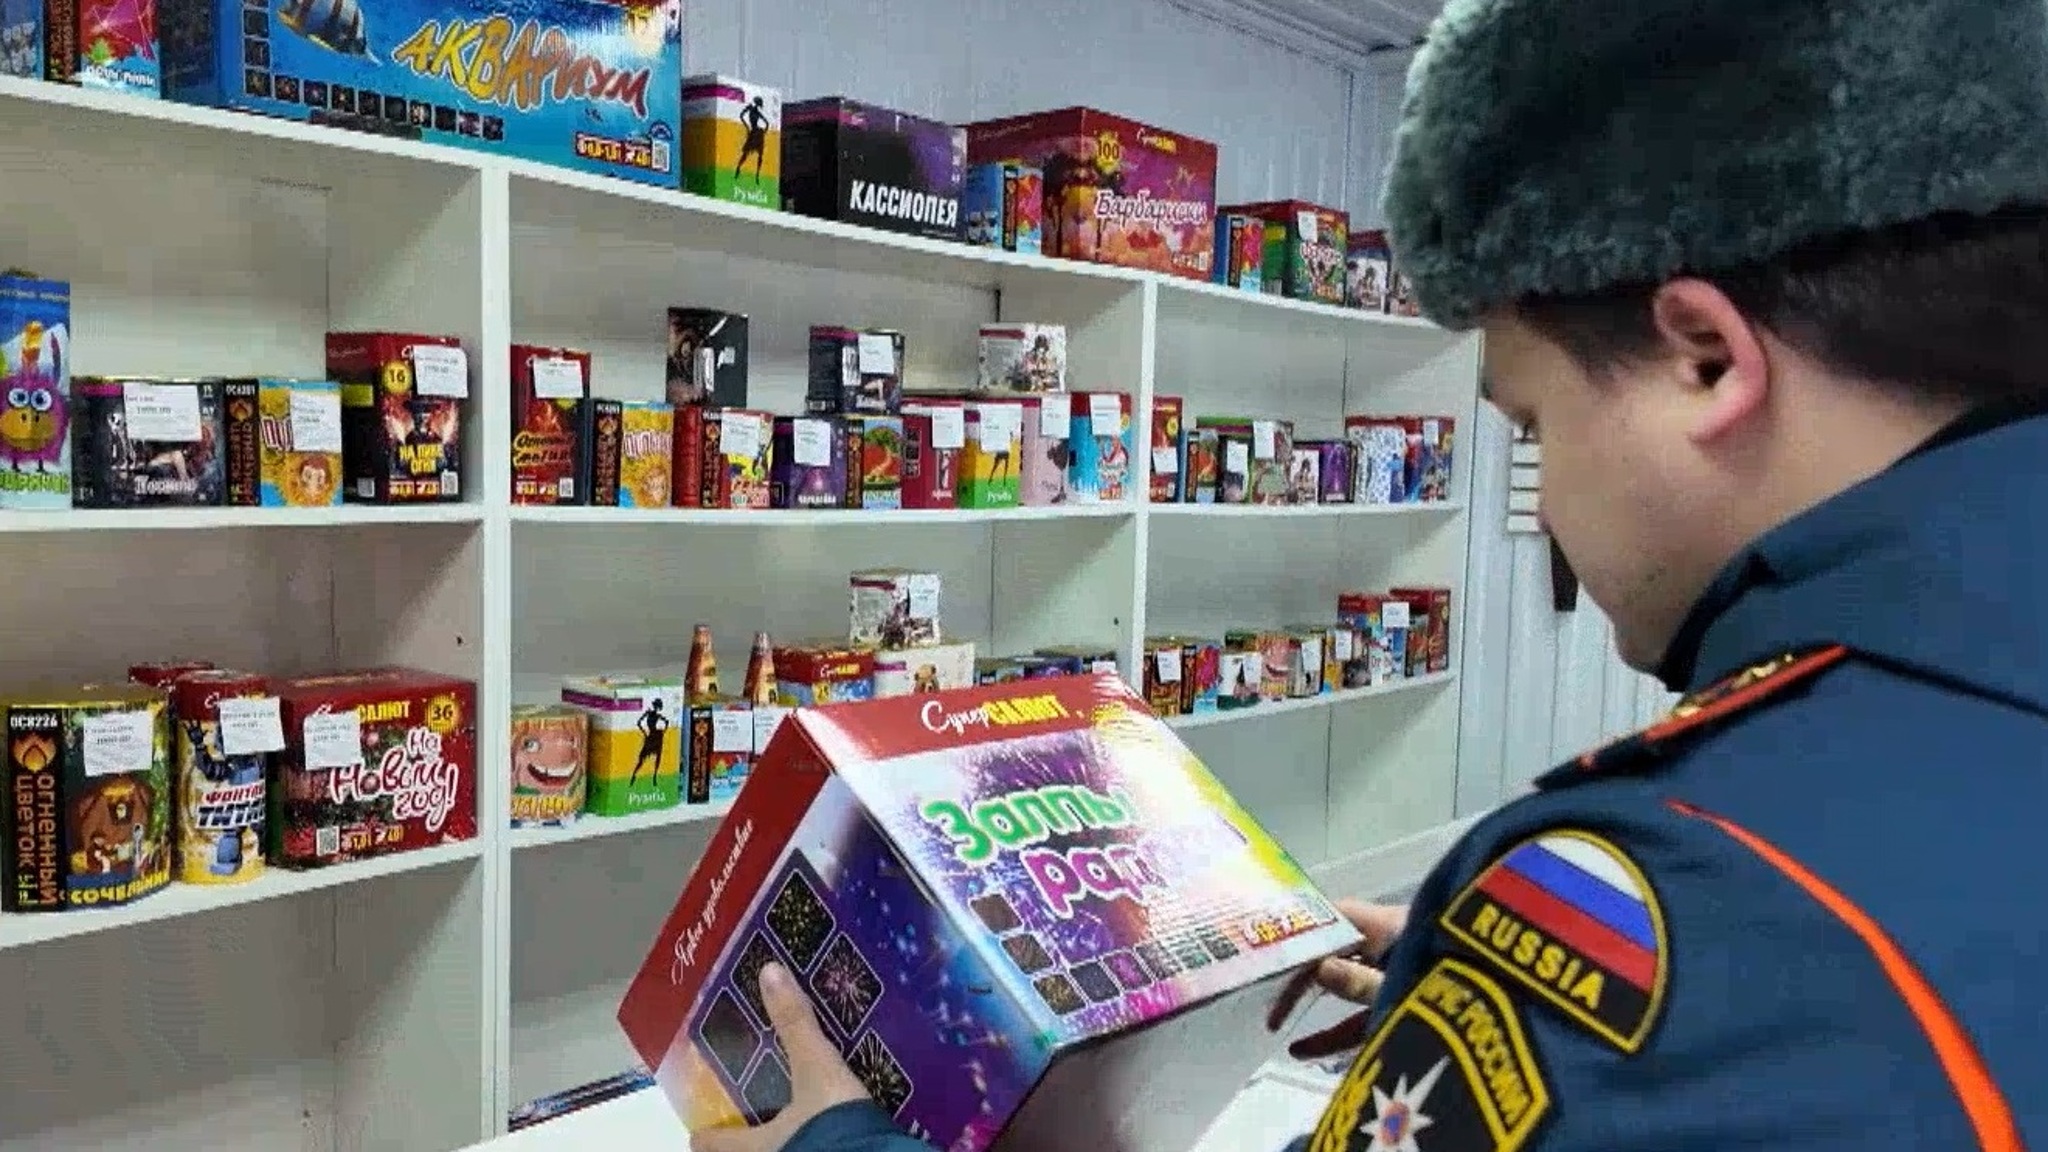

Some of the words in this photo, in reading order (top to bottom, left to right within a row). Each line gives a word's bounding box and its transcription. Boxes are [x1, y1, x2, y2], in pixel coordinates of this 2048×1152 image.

[1098, 139, 1121, 158] 100
[850, 180, 958, 228] КАССИОПЕЯ
[389, 369, 406, 384] 16
[431, 703, 454, 722] 36
[1471, 903, 1605, 1011] RUSSIA
